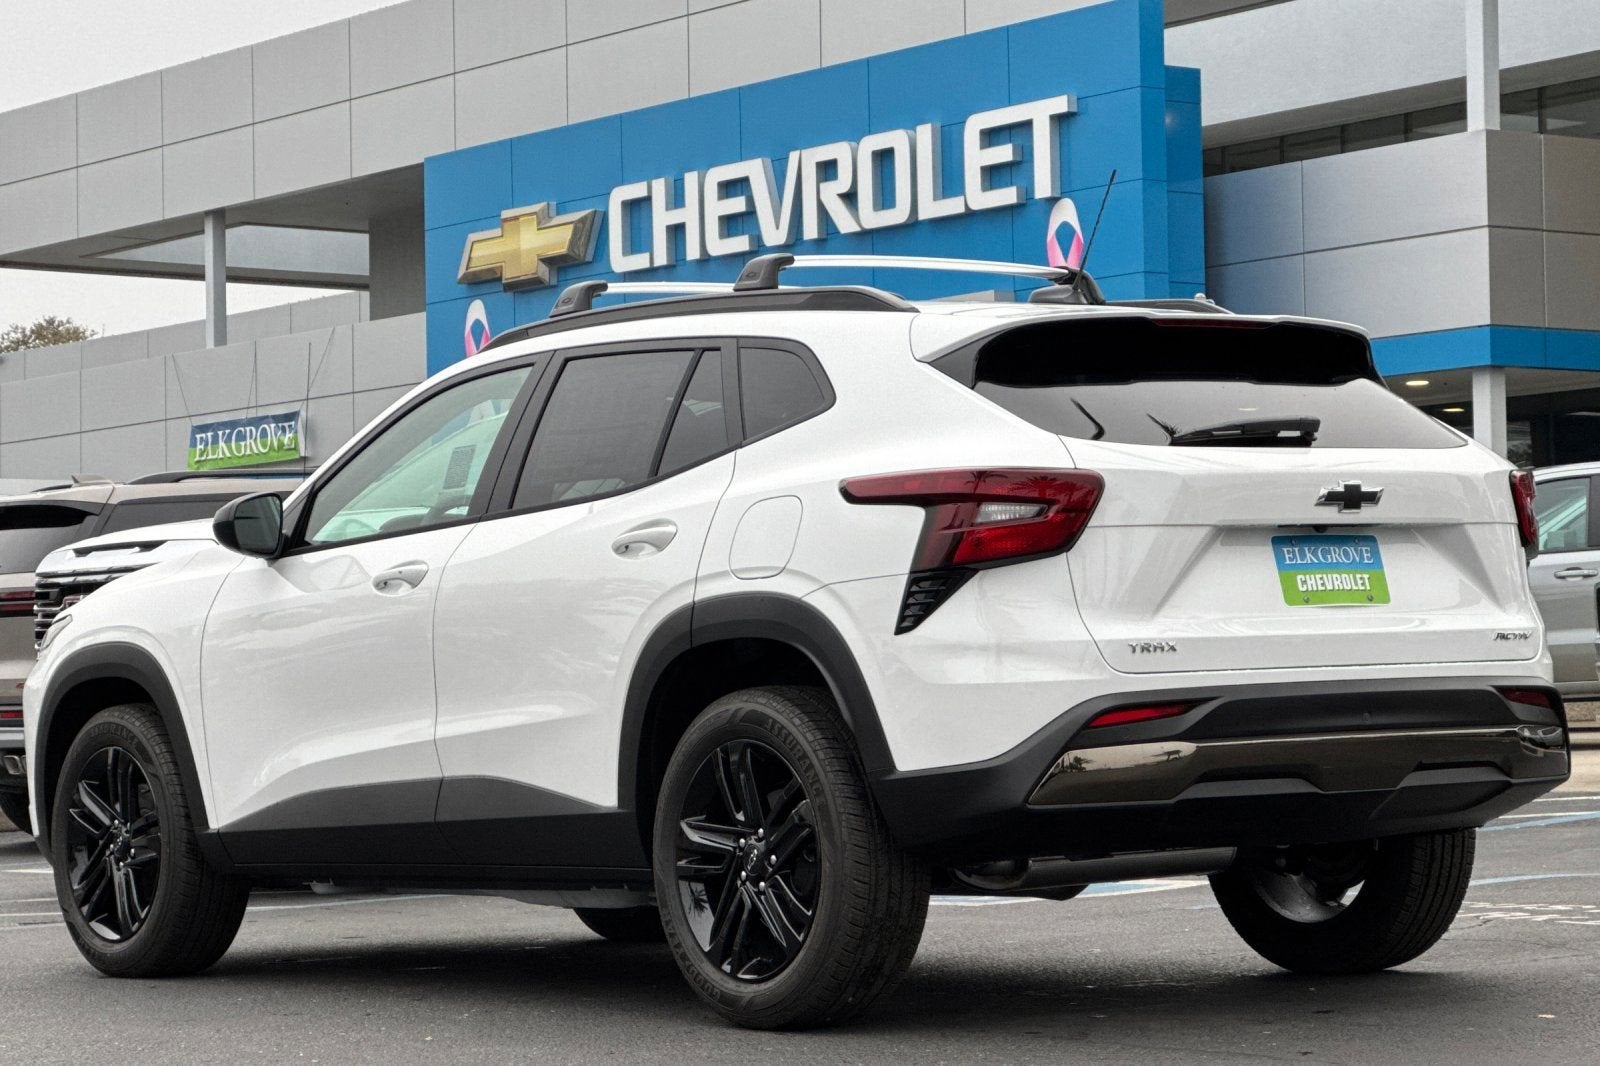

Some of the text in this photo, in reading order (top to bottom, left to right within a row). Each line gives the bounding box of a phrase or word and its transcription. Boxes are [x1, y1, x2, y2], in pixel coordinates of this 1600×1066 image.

[608, 94, 1077, 274] CHEVROLET
[1296, 573, 1371, 592] CHEVROLET
[1127, 641, 1177, 654] TRAX
